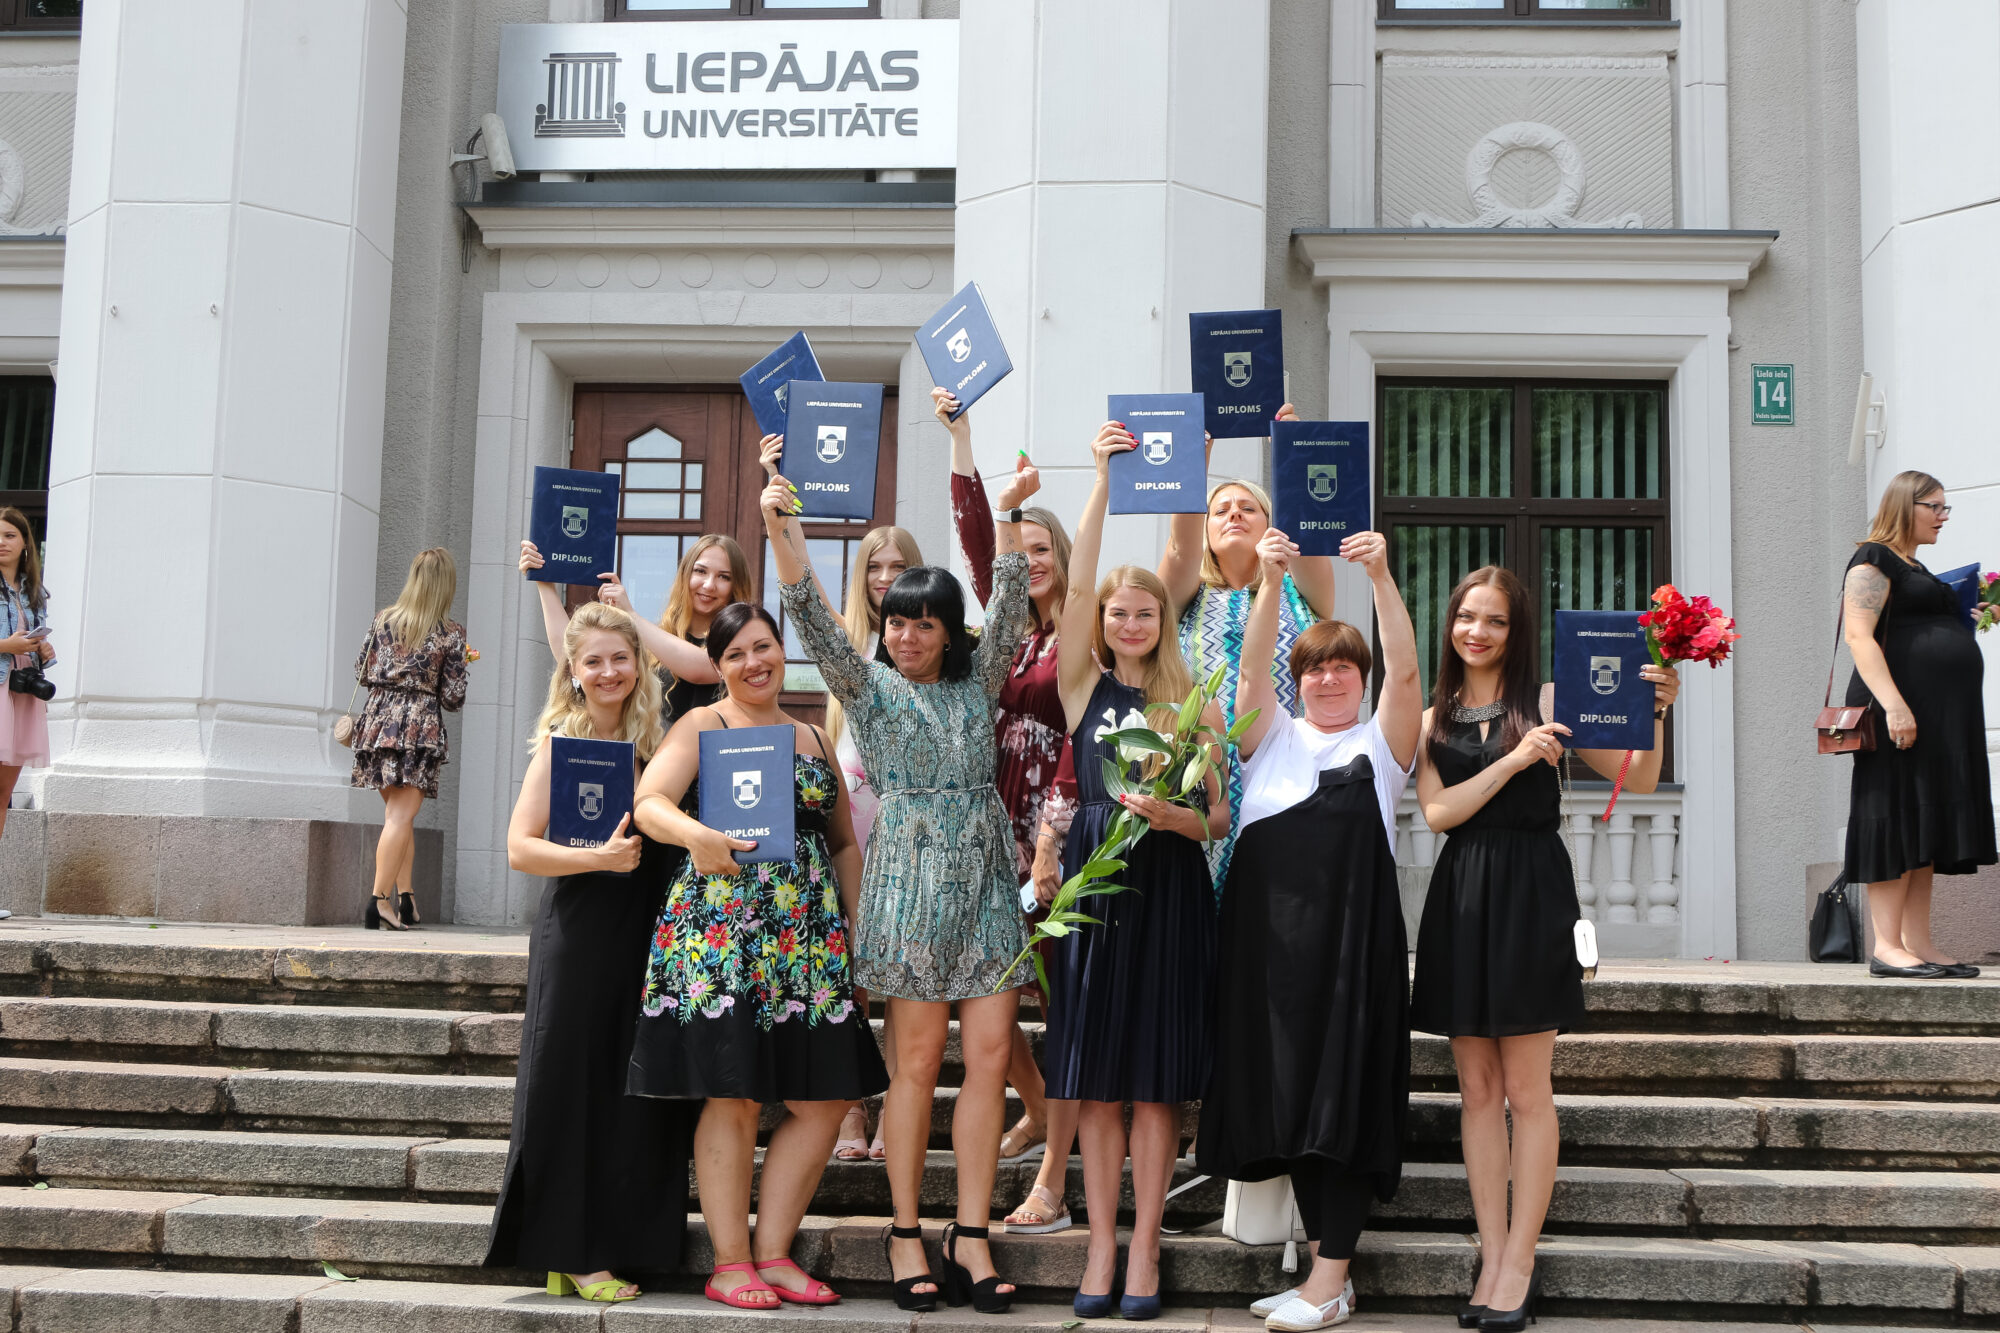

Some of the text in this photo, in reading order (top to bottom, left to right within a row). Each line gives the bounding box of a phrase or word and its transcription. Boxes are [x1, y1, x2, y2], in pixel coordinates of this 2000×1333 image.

[645, 43, 920, 94] LIEPĀJAS
[643, 103, 918, 138] UNIVERSITĀTE
[957, 360, 987, 390] DIPLOMS
[1775, 370, 1788, 378] iela
[1758, 381, 1787, 408] 14
[1218, 405, 1261, 414] DIPLOMS
[804, 481, 850, 493] DIPLOMS
[1135, 482, 1181, 490] DIPLOMS
[1300, 521, 1346, 530] DIPLOMS
[551, 552, 593, 564] DIPLOMS
[1579, 713, 1628, 724] DIPLOMS
[724, 827, 771, 838] DIPLOMS
[570, 837, 608, 849] DIPLOM
